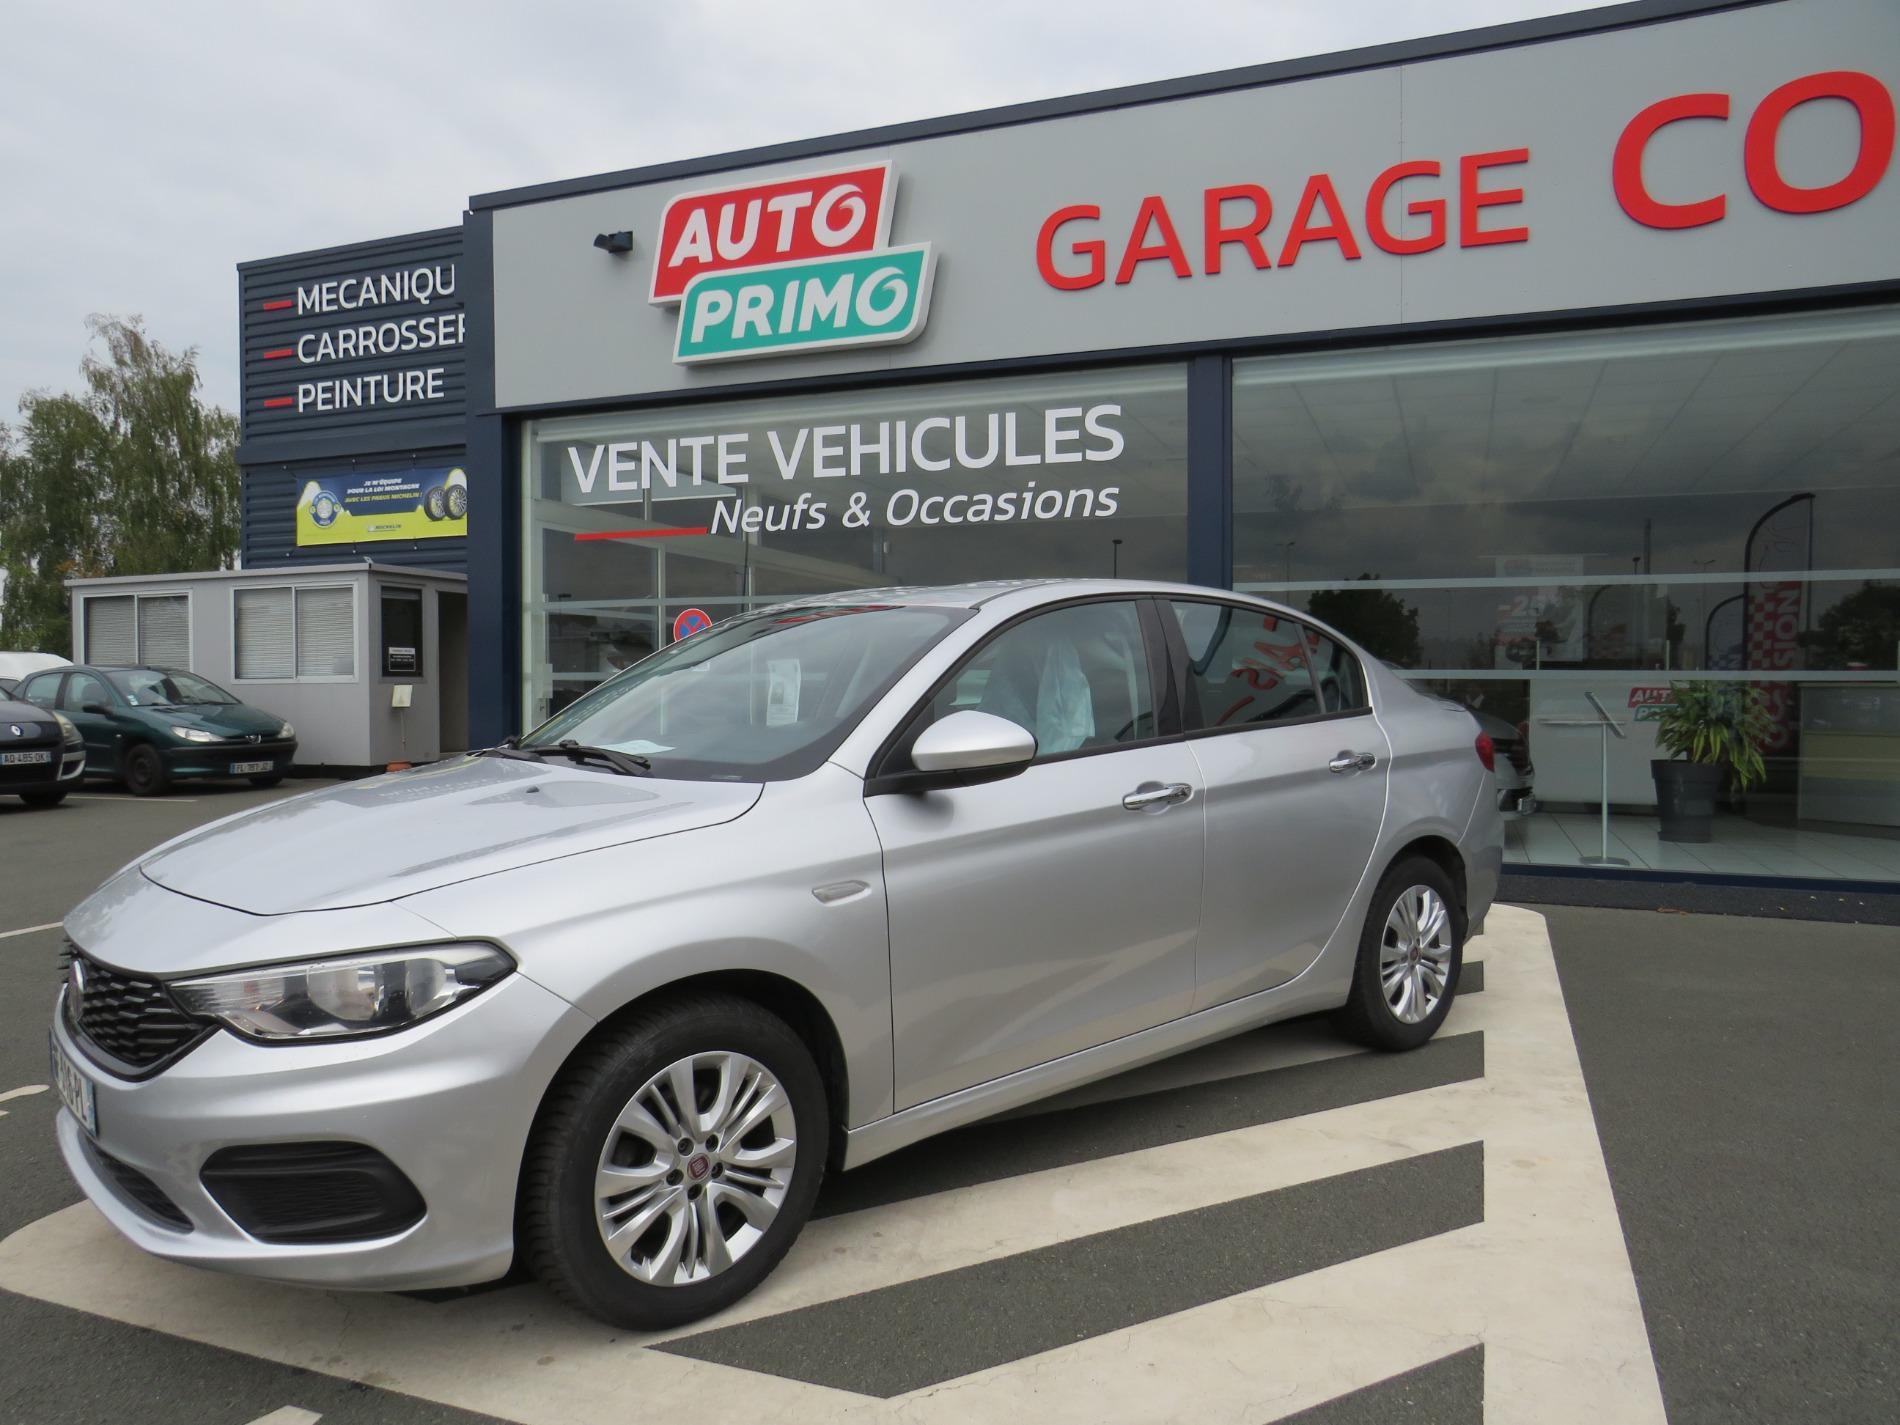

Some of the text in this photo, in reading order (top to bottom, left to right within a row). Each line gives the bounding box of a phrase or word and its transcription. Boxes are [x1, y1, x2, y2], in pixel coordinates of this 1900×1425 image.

[1036, 71, 1896, 291] GARAGE CO
[668, 184, 867, 268] AUTO
[297, 264, 455, 315] MECANIQU
[690, 267, 909, 344] PRIMO
[298, 367, 445, 413] PEINTURE
[568, 404, 1125, 493] VENTE VEHICULES
[711, 481, 1120, 534] Neufs & Occasions
